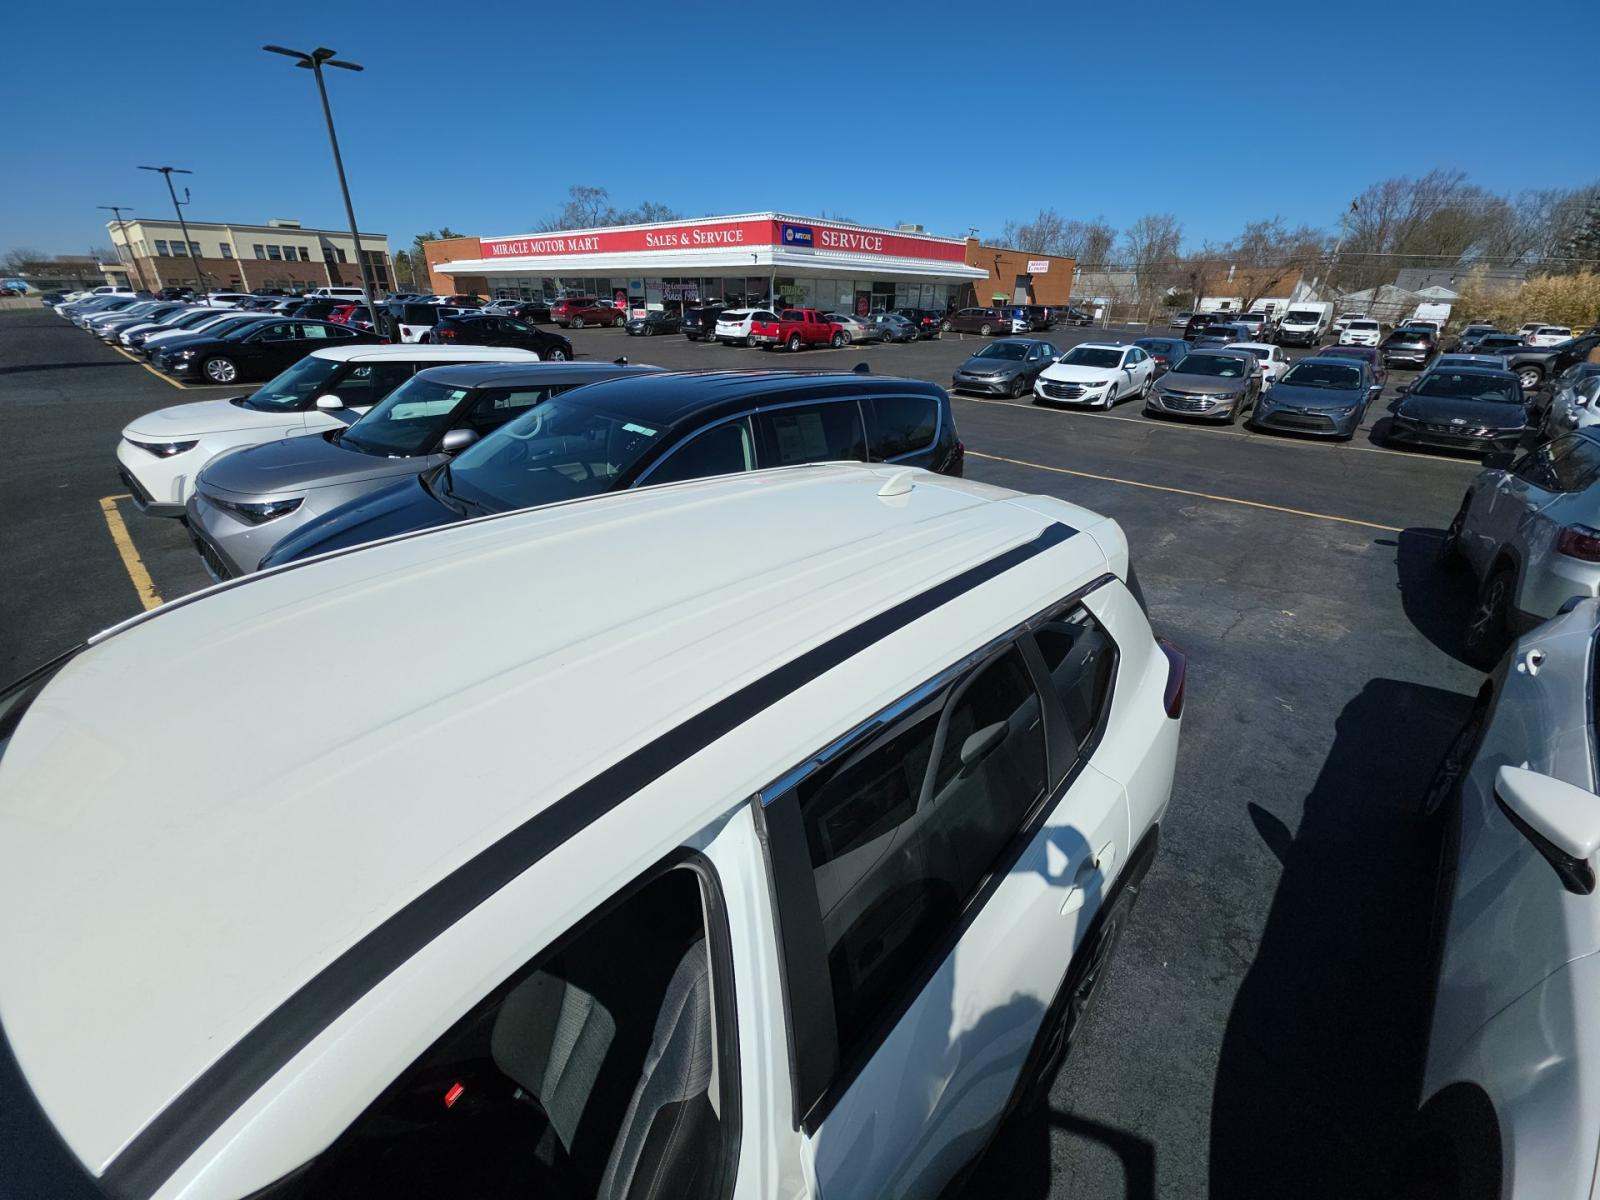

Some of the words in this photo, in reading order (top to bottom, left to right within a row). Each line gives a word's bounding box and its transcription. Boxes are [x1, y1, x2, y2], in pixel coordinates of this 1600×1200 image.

[492, 242, 529, 255] MIRACLE
[530, 239, 565, 253] MOTOR
[567, 236, 600, 251] MART
[646, 232, 678, 247] SALES
[680, 232, 690, 245] &
[692, 229, 744, 244] SERVICE
[821, 230, 883, 251] SERVICE
